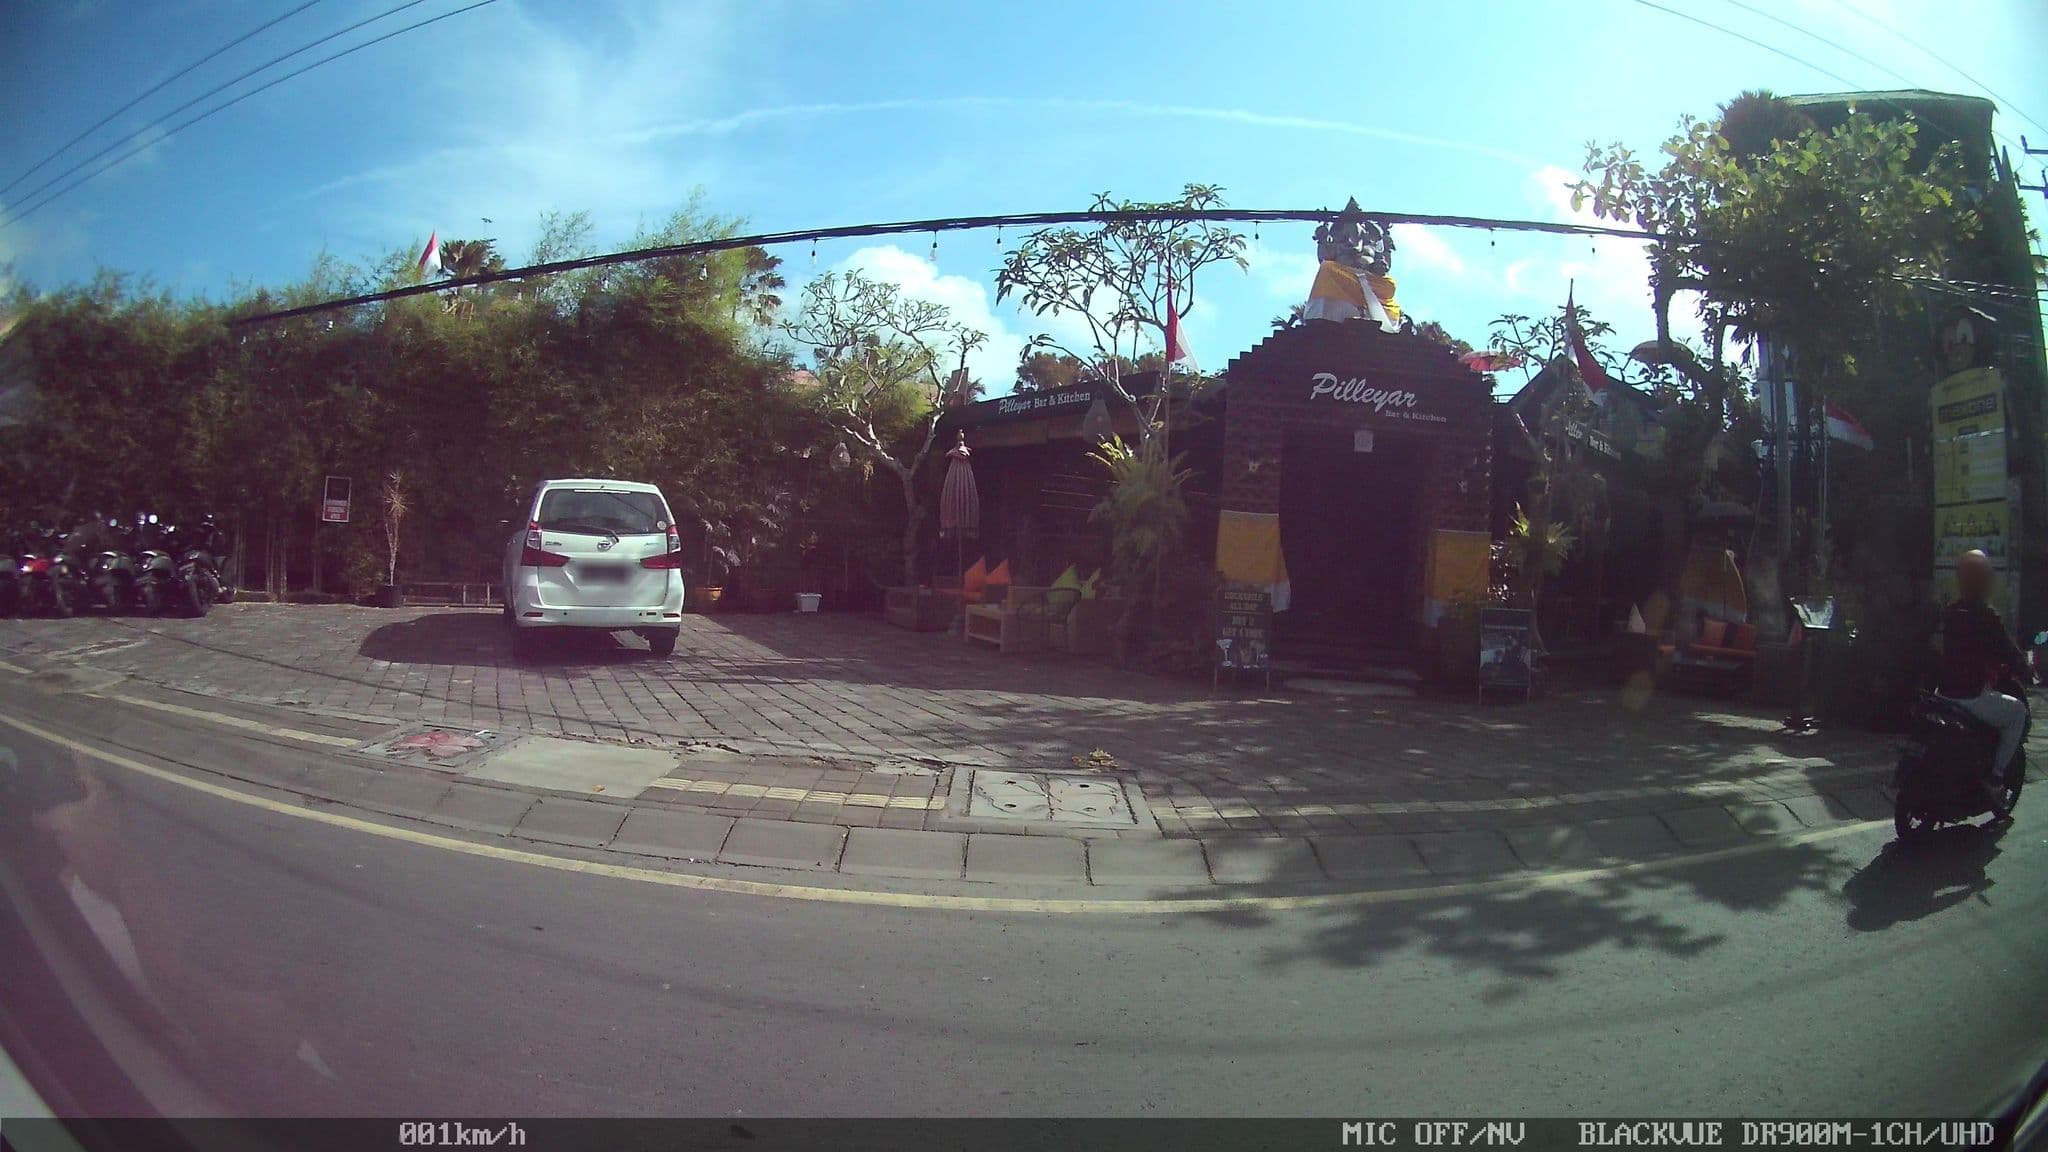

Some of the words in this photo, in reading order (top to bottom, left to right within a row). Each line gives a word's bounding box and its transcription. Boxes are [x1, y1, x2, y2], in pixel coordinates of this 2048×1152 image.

[998, 398, 1032, 414] Pilleyar
[1034, 398, 1047, 409] Bar
[1049, 395, 1056, 406] &
[1057, 391, 1091, 405] Kitchen
[1310, 372, 1417, 413] Pilleyar
[1385, 409, 1400, 418] Bar
[1403, 411, 1410, 419] &
[1412, 412, 1447, 423] Kitchen
